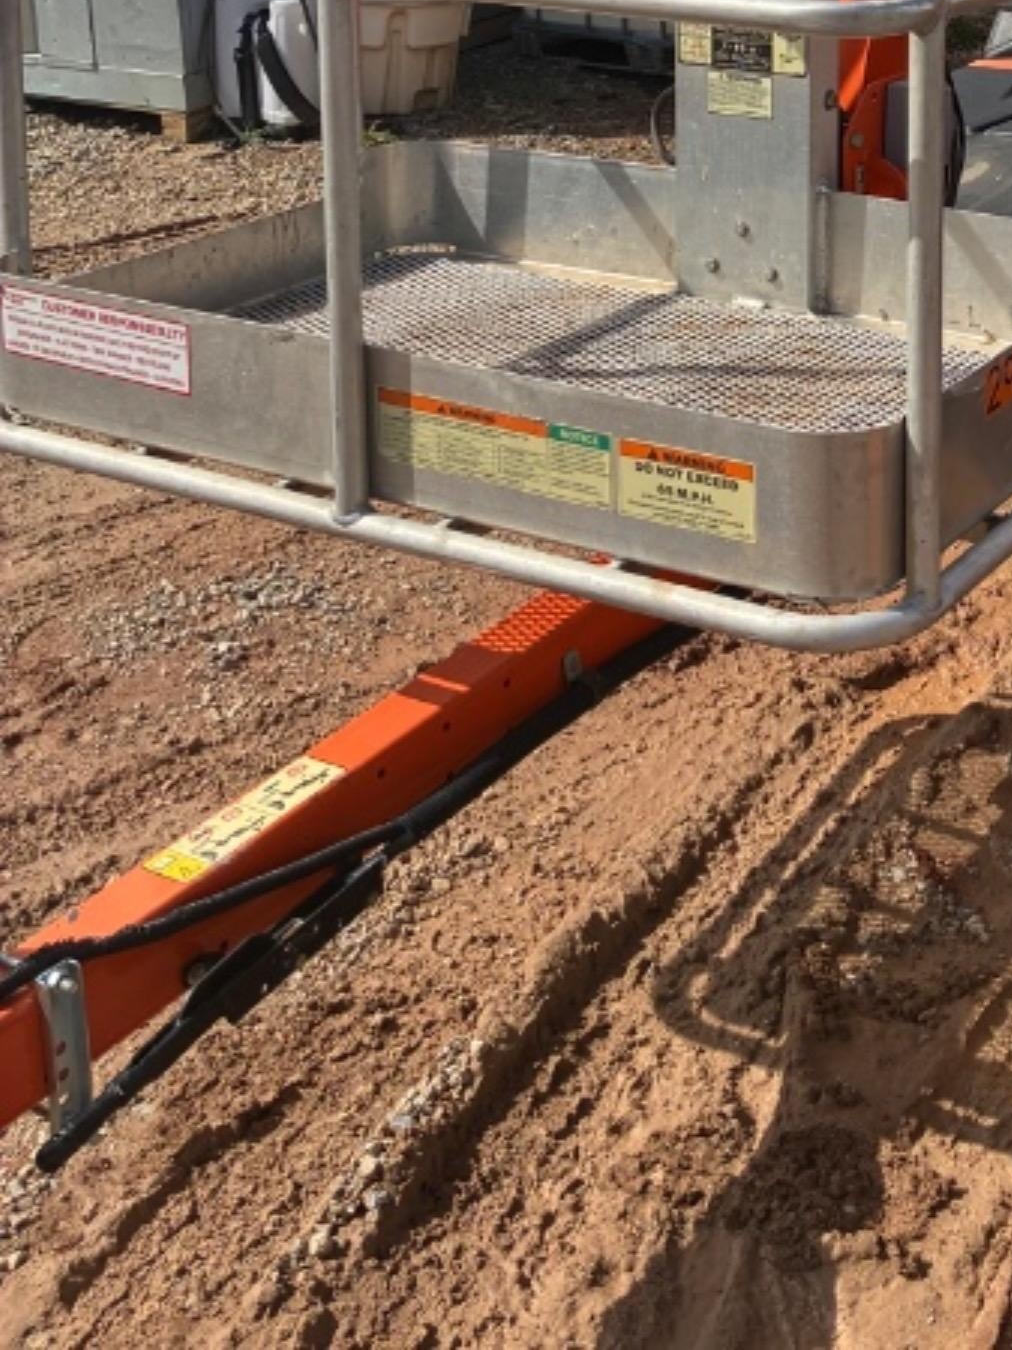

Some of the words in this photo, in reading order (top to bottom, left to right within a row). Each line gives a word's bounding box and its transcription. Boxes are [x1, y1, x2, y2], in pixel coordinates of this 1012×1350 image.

[41, 299, 96, 321] CUSTOMER
[559, 428, 598, 446] NOTICE
[662, 449, 727, 473] WARNING
[635, 460, 654, 475] DO
[656, 465, 683, 480] NOT
[686, 470, 739, 492] EXCEED
